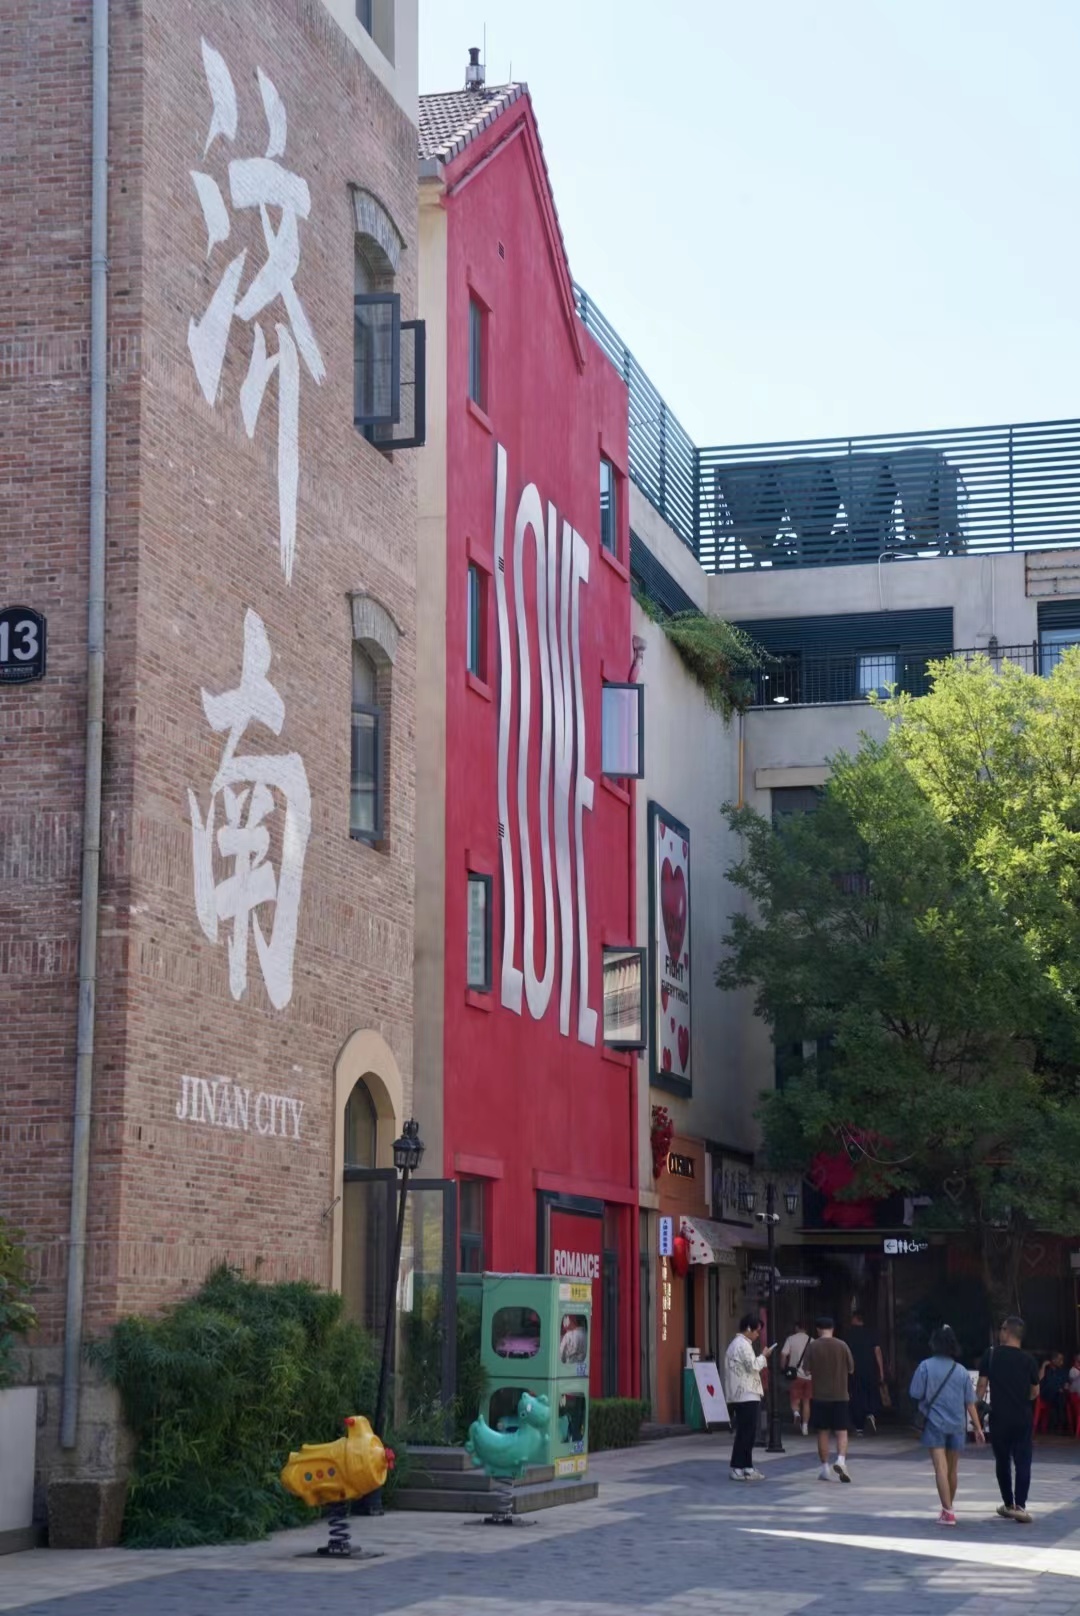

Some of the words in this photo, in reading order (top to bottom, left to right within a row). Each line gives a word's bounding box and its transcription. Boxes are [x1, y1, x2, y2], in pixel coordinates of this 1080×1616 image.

[494, 442, 598, 1048] LOVE
[665, 954, 684, 983] FIGHT
[176, 1075, 251, 1131] JINAN
[255, 1092, 304, 1140] CITY
[554, 1249, 600, 1279] ROMANCE
